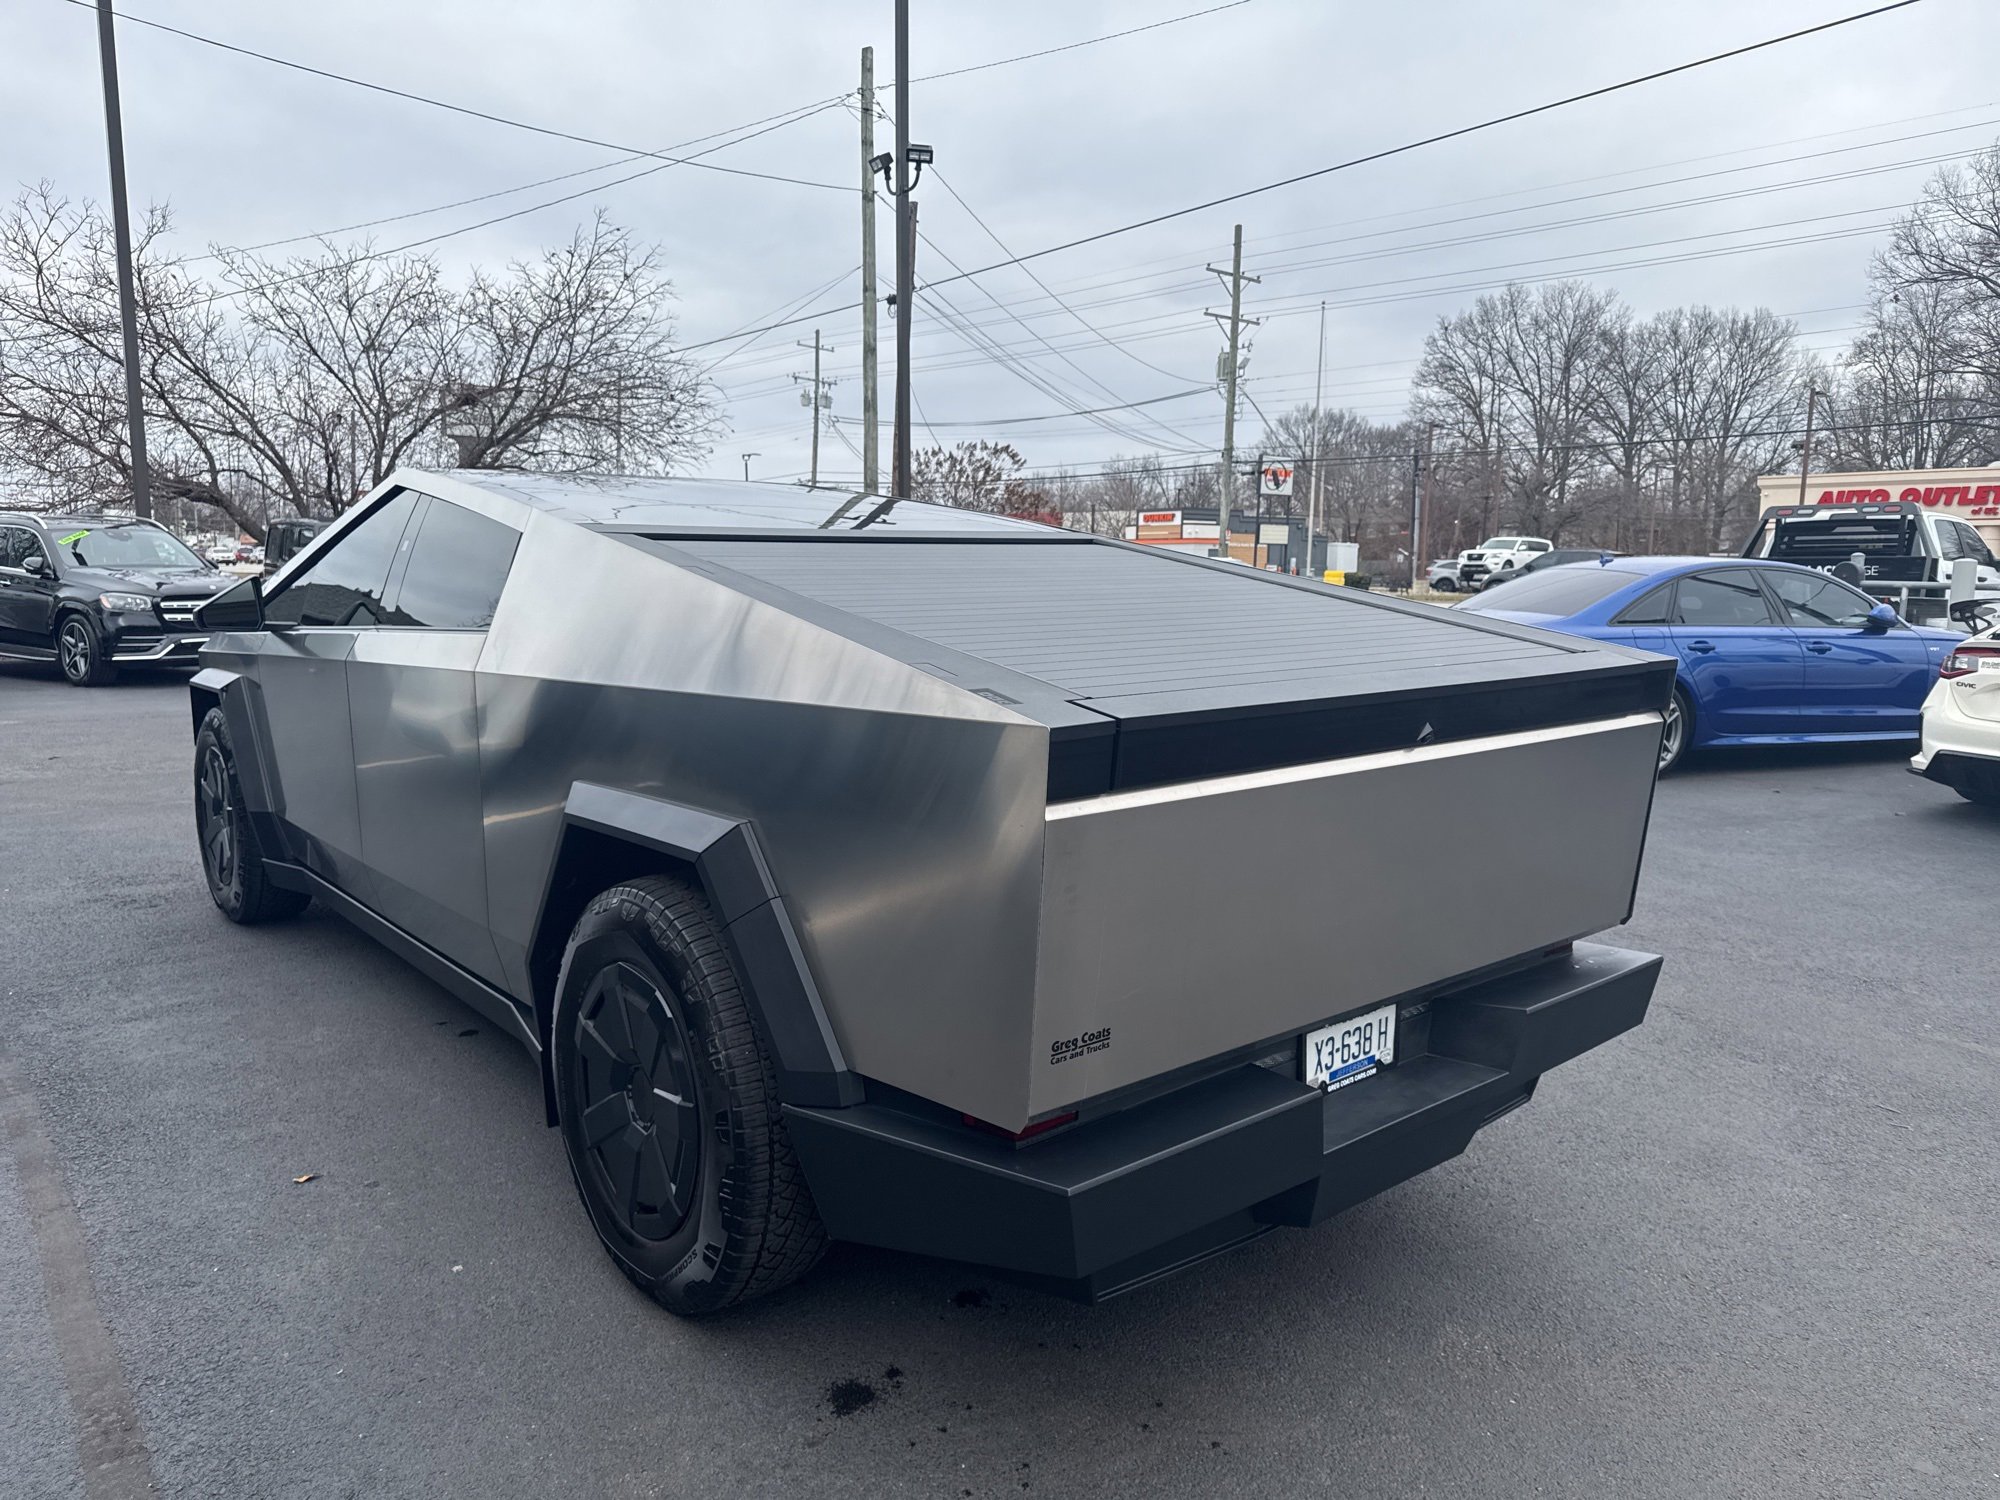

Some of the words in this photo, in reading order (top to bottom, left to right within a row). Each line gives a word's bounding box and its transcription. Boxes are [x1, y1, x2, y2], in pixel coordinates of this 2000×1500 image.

[1817, 489, 1891, 504] AUTO
[1900, 485, 2000, 507] OUTLET
[1956, 681, 1977, 689] CIVIC
[1051, 1037, 1078, 1052] Greg
[1081, 1027, 1111, 1043] Coats
[1315, 1022, 1373, 1076] X3-638
[1378, 1016, 1388, 1051] H
[1051, 1055, 1067, 1065] Cars
[1069, 1048, 1084, 1059] and
[1087, 1042, 1110, 1054] Trucks
[1336, 1058, 1369, 1077] JEFFERSON
